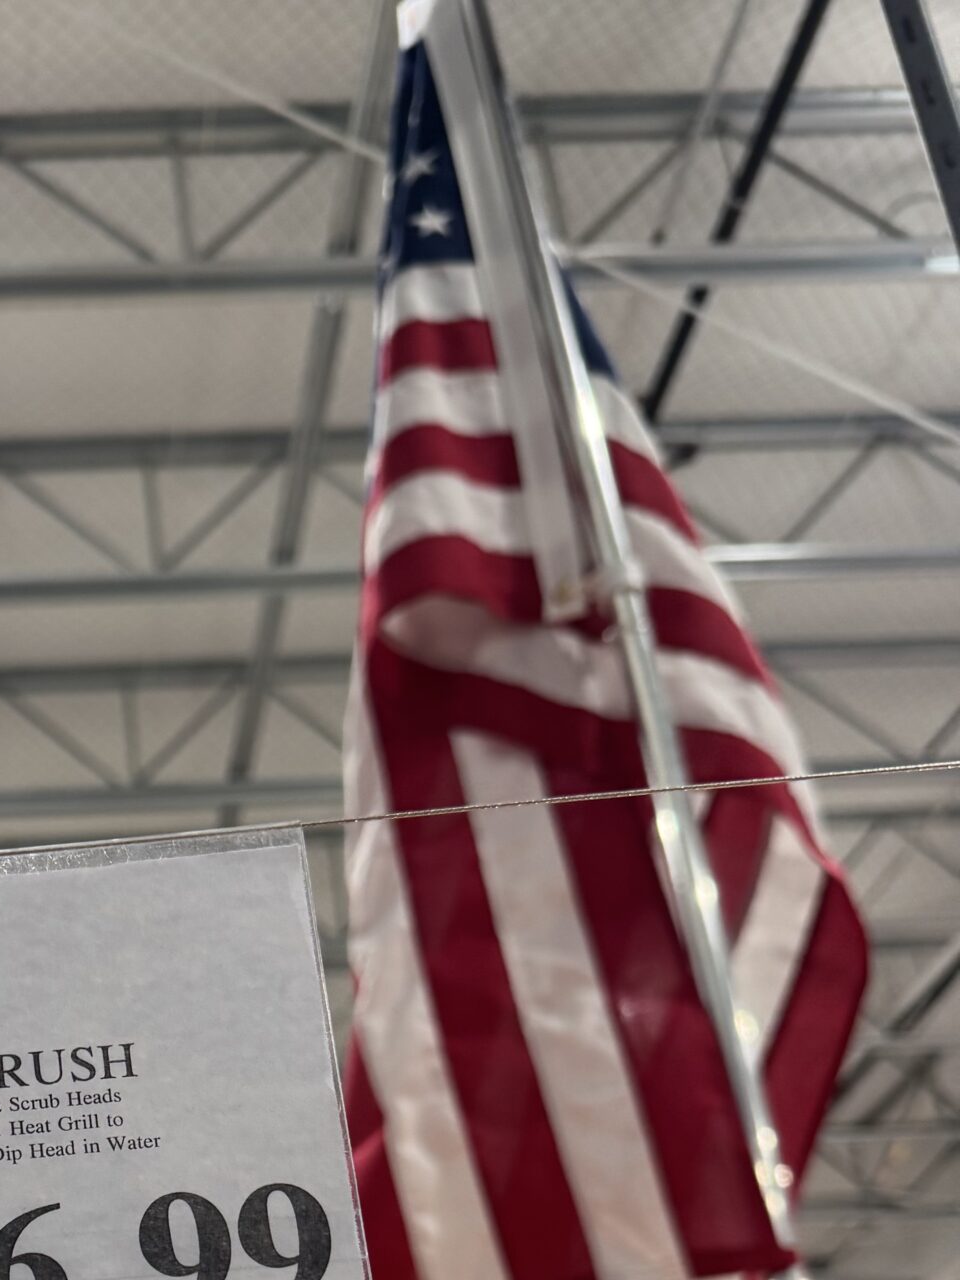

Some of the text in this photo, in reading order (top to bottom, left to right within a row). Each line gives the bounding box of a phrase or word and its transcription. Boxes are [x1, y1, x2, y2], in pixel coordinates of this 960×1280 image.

[8, 1093, 61, 1112] Scrub
[66, 1087, 122, 1107] Heads
[8, 1118, 52, 1137] Heat
[57, 1113, 101, 1132] Grill
[106, 1114, 124, 1128] to
[28, 1139, 77, 1159] Head
[82, 1137, 101, 1154] in
[105, 1133, 161, 1152] Water
